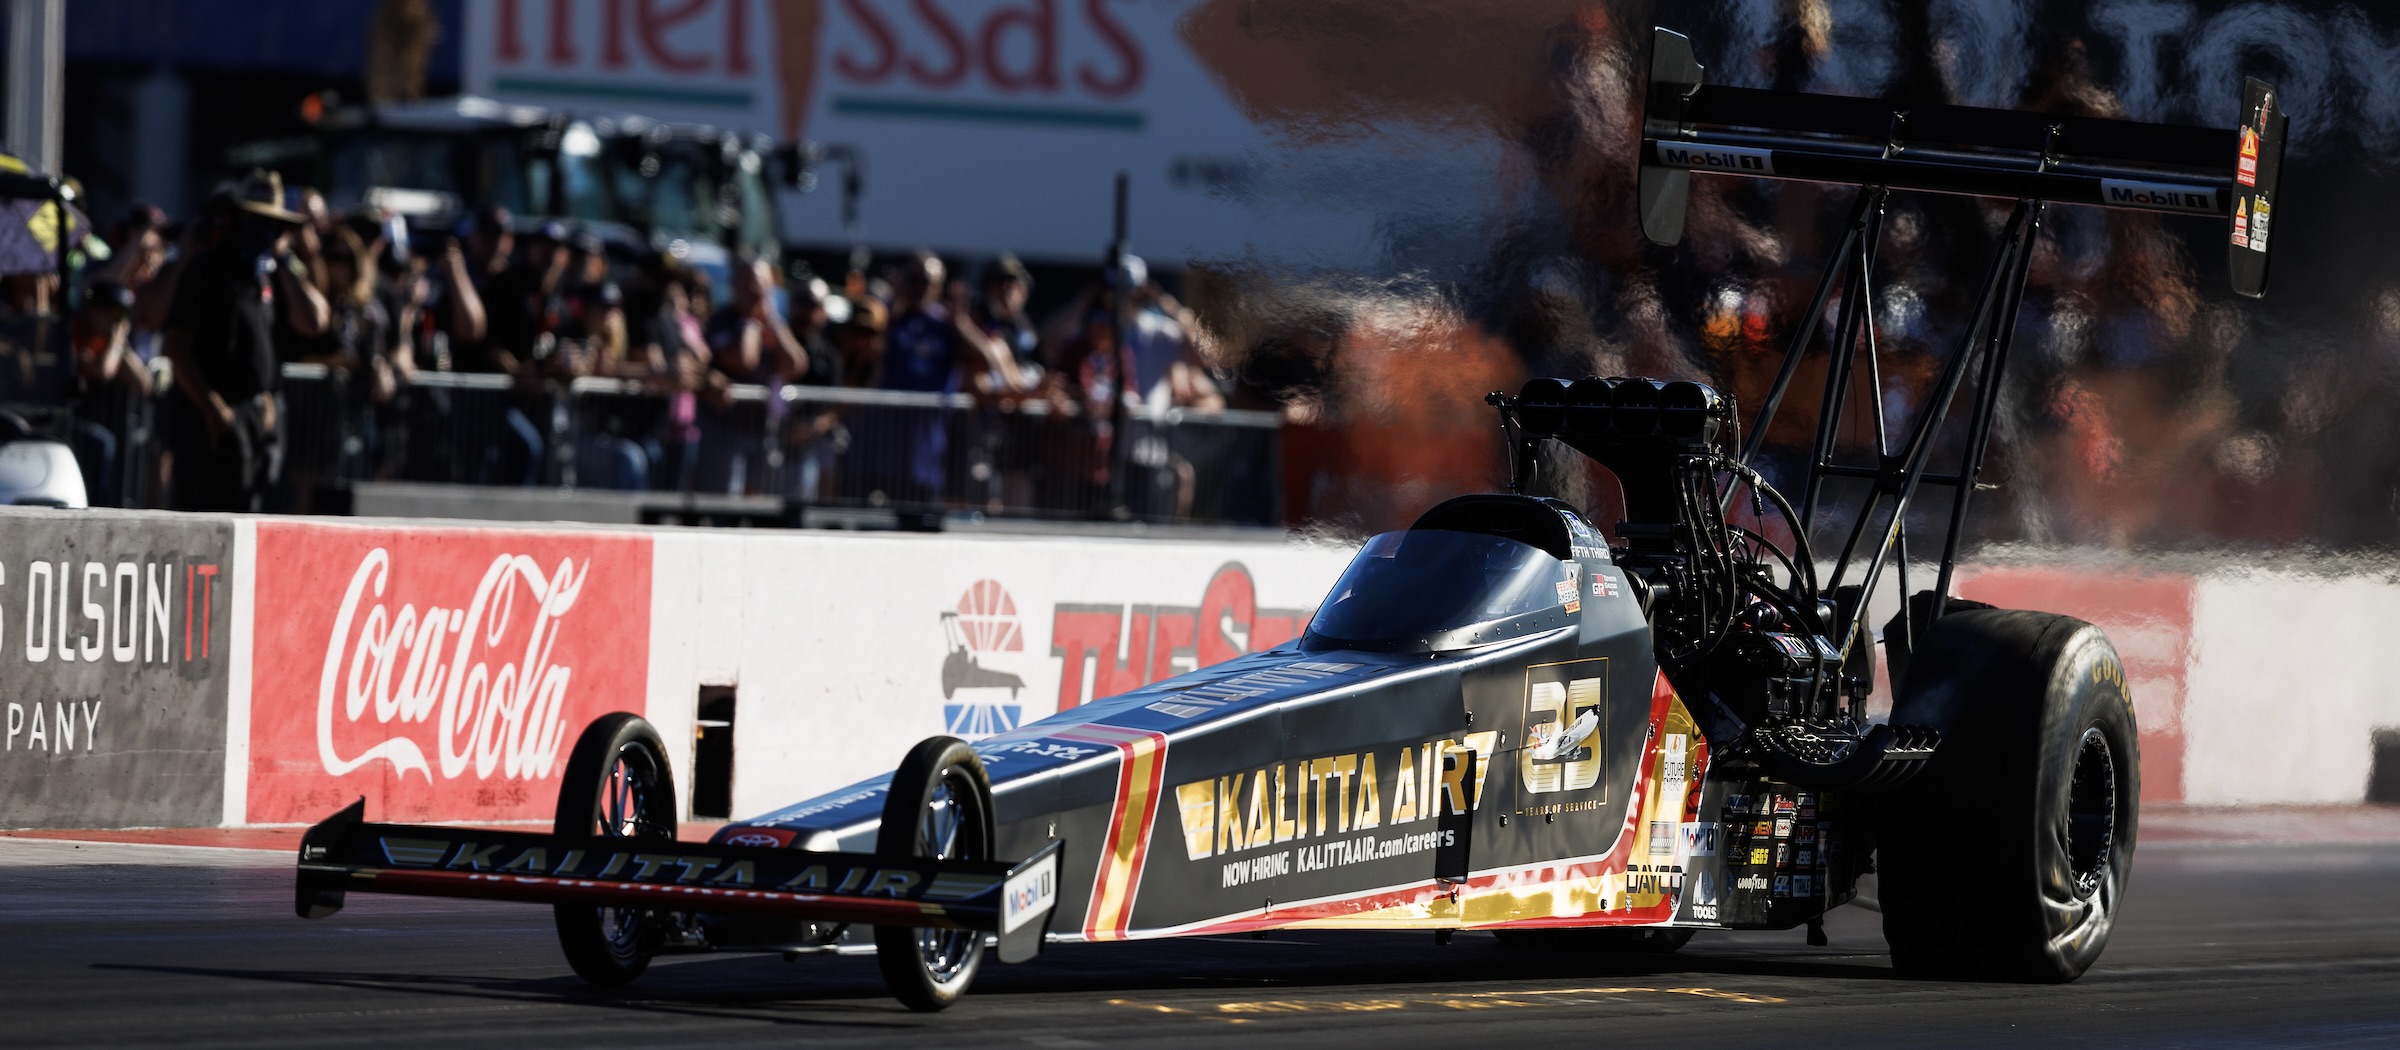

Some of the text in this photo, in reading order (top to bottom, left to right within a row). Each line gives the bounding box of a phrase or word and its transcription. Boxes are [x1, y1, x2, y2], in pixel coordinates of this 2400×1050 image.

[1666, 149, 1736, 168] Mobil
[2111, 187, 2180, 206] Mobil
[1570, 546, 1610, 559] FIFTH THIRD
[1592, 583, 1605, 595] GR
[317, 547, 591, 786] Coca-Cola
[1521, 676, 1601, 794] 25
[1664, 761, 1684, 777] FUTURE
[1217, 738, 1469, 855] KALITTA AIR
[1525, 800, 1598, 817] YEARS OF SERVICE
[1222, 828, 1455, 888] NOW HIRING KALITTAAIR.com/careers
[1750, 848, 1769, 864] JEGS
[446, 842, 755, 885] KALITTA
[786, 862, 921, 897] AIR
[1626, 864, 1683, 895] DAYCO
[1737, 876, 1768, 891] GOODYEAR
[1010, 877, 1038, 917] Mobil
[1692, 906, 1717, 920] TOOLS
